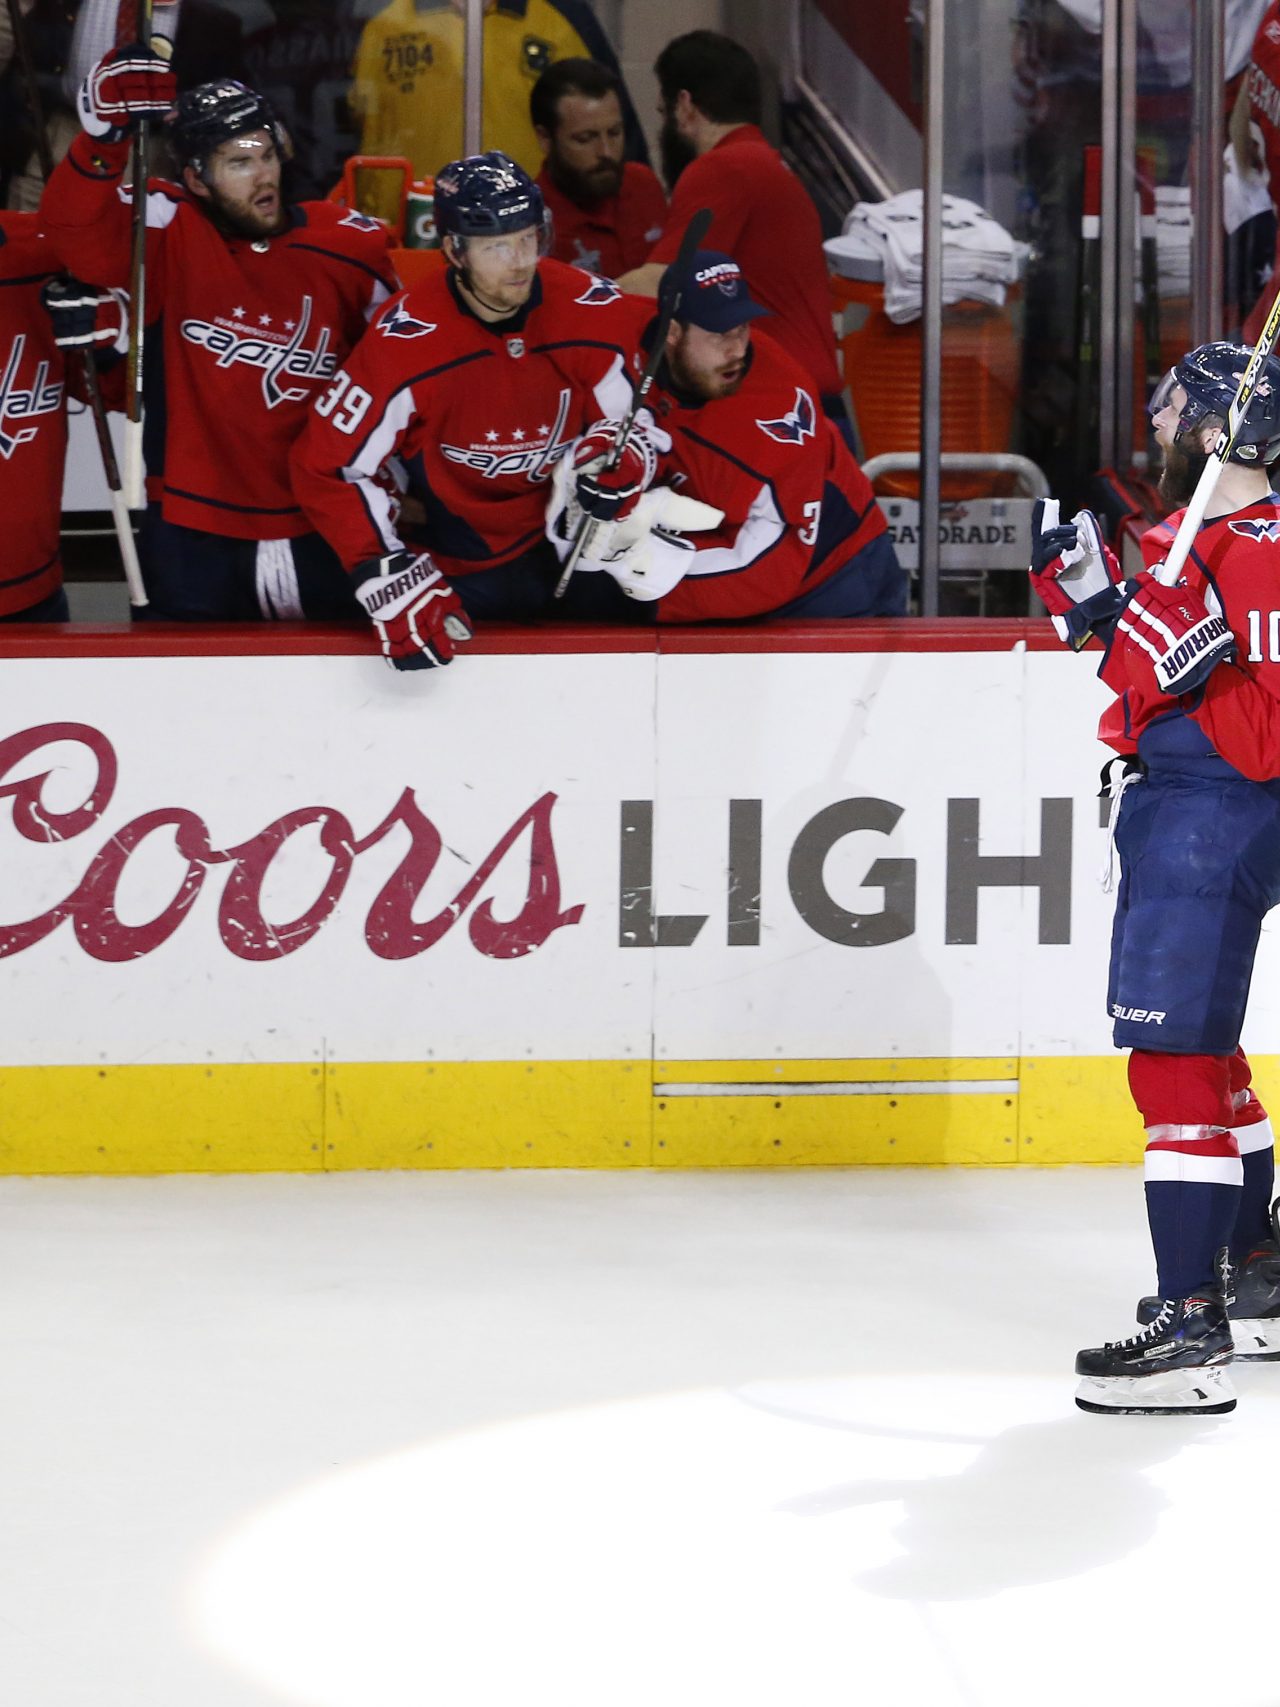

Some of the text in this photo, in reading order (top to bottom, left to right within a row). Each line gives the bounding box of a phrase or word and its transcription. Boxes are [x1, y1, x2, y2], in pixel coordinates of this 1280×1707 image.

[180, 294, 338, 410] capitals
[313, 368, 374, 436] 39
[1160, 616, 1229, 681] ARRIOR
[0, 721, 1116, 963] Coors LIGH
